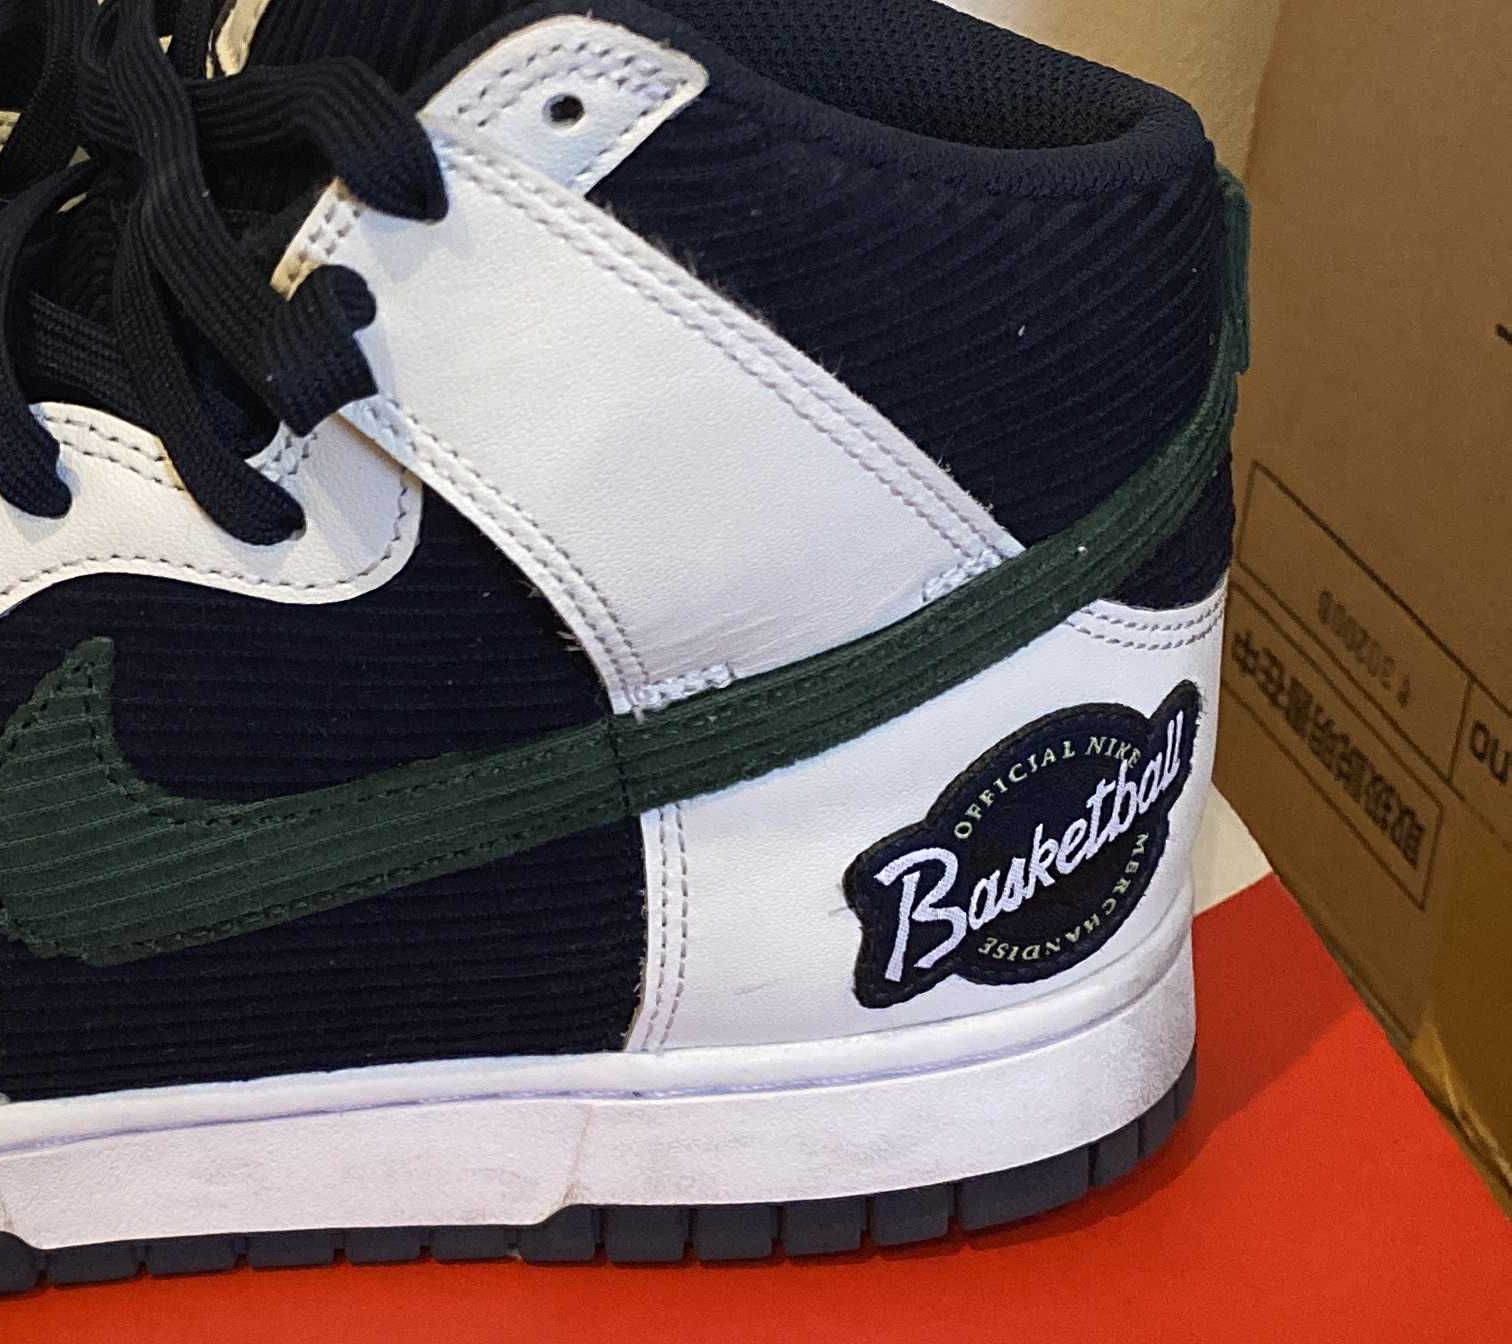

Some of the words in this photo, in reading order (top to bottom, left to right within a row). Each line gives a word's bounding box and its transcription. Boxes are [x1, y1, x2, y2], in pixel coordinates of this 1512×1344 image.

[874, 710, 1184, 983] Basketball
[954, 741, 1076, 839] OFFICIAL
[1085, 736, 1141, 768] NIKE
[978, 832, 1149, 962] MERCHANDISE
